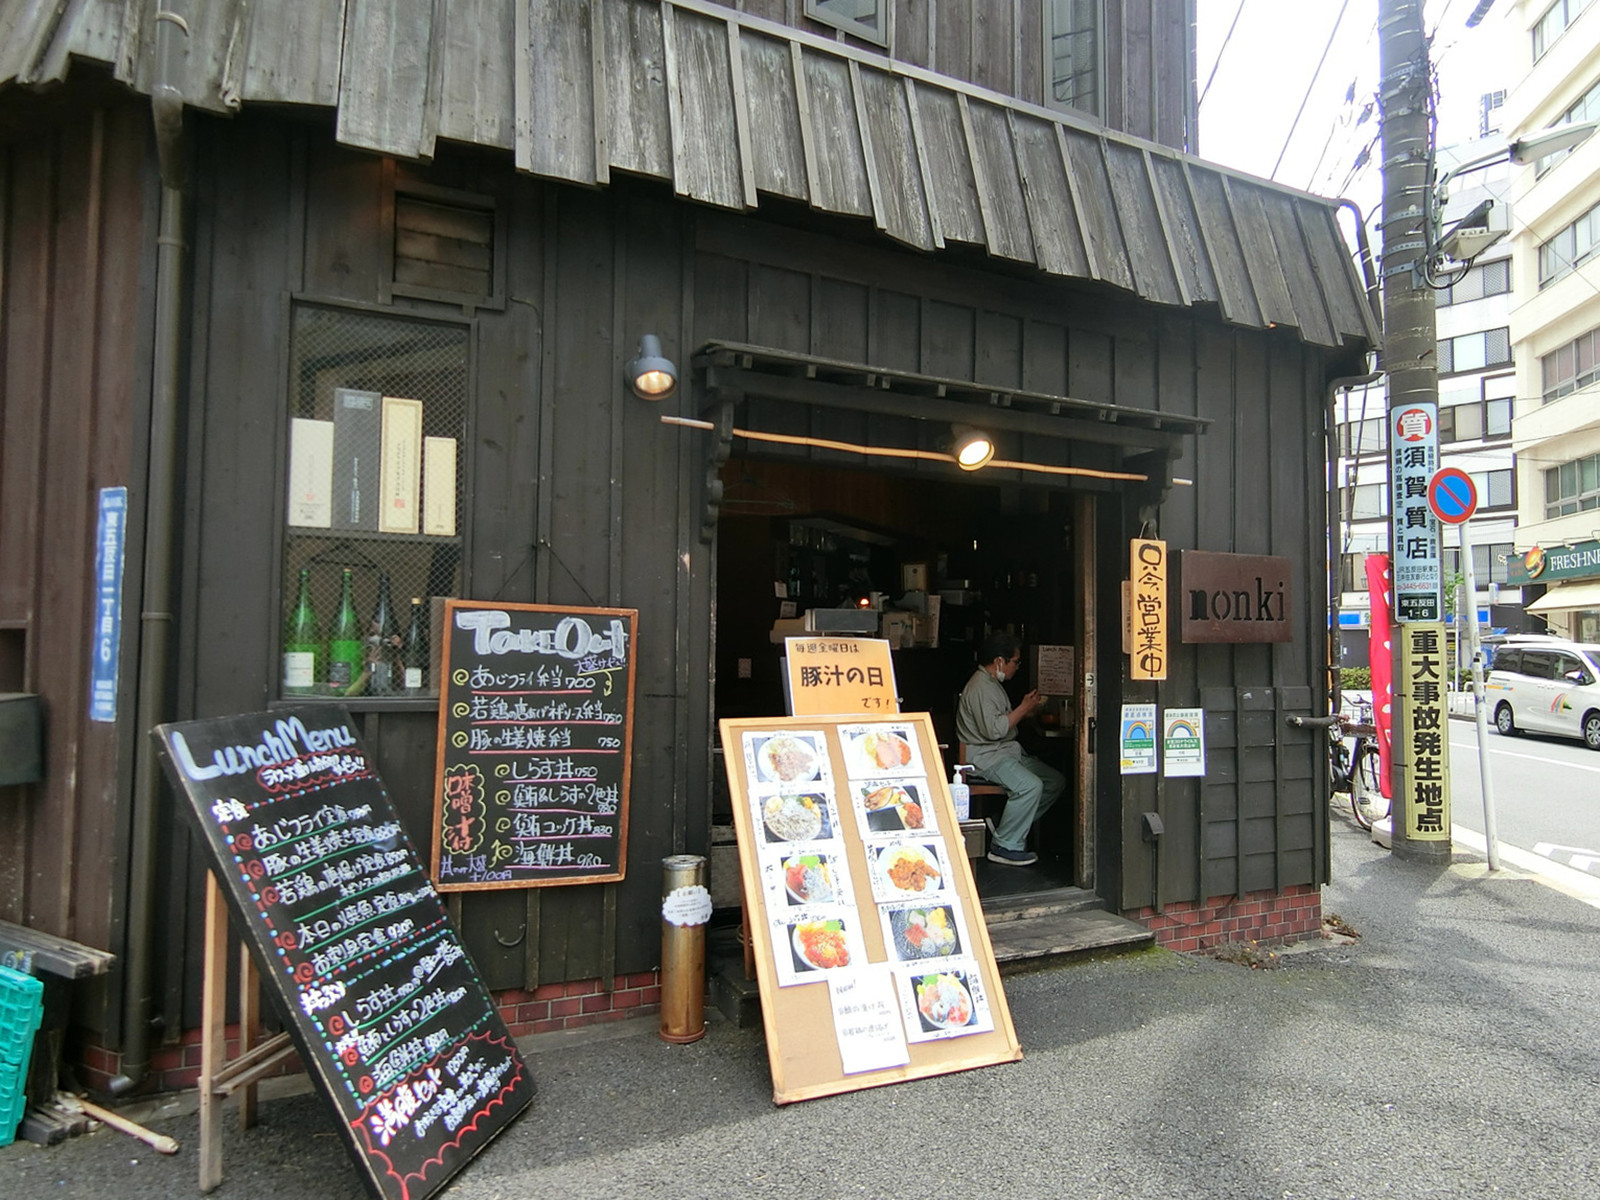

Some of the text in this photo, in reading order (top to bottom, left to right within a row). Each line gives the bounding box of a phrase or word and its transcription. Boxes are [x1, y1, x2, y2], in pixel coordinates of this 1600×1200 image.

[1401, 413, 1428, 439] 質
[1403, 445, 1428, 560] 須賀質店
[1136, 542, 1164, 677] 只今営業中
[1189, 577, 1285, 621] nonki
[1401, 599, 1435, 607] 東五反田
[1408, 609, 1429, 617] 1-6
[101, 637, 112, 662] 6
[456, 611, 628, 658] Take Out
[795, 642, 859, 654] 毎週金曜日は
[470, 665, 596, 689] あじフライ弁当 700
[801, 665, 884, 687] 豚汁の日
[602, 712, 622, 724] 750
[861, 698, 890, 709] です!
[598, 737, 621, 748] 750
[1411, 630, 1443, 832] 重大事故発生地点
[171, 730, 285, 781] Lunch
[512, 757, 598, 780] しらす丼 750
[211, 797, 249, 823] 定食
[251, 805, 349, 850] あじフライ定食
[447, 774, 476, 850] 味噌汁付
[593, 825, 614, 835] 830
[262, 825, 374, 877] 豚の生姜焼き定食
[514, 841, 575, 868] 海鮮丼
[276, 850, 386, 906] 若鶏の唐揚げ定食
[296, 889, 402, 949] 本日の焼魚定食
[310, 927, 388, 975] お刺身定食
[341, 983, 398, 1028] しらす丼
[371, 1038, 426, 1087] 海鮮丼
